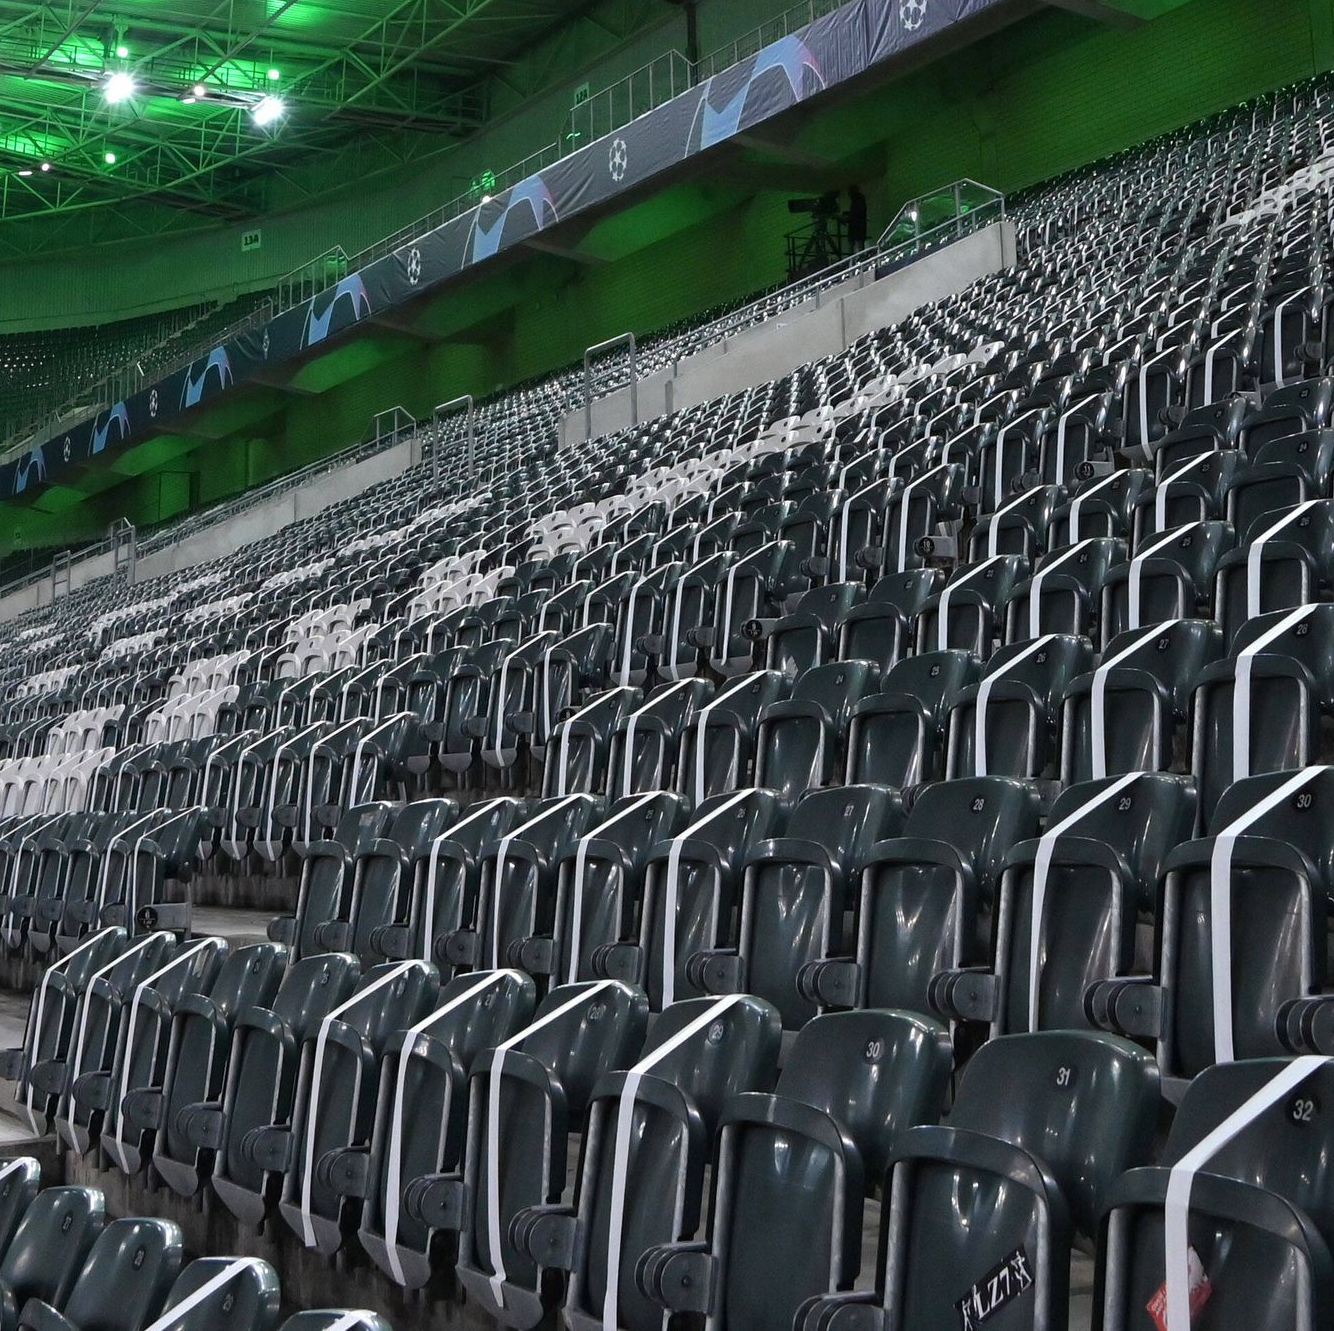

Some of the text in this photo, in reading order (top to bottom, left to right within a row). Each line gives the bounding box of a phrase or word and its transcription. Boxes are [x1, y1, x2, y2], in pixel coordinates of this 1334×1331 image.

[244, 234, 259, 246] 13A
[1297, 623, 1307, 634] 28
[973, 798, 984, 811] 28
[1119, 798, 1132, 811] 29
[1296, 794, 1312, 809] 30
[866, 1041, 880, 1057] 30
[1056, 1067, 1071, 1086] 31
[1293, 1100, 1313, 1121] 32
